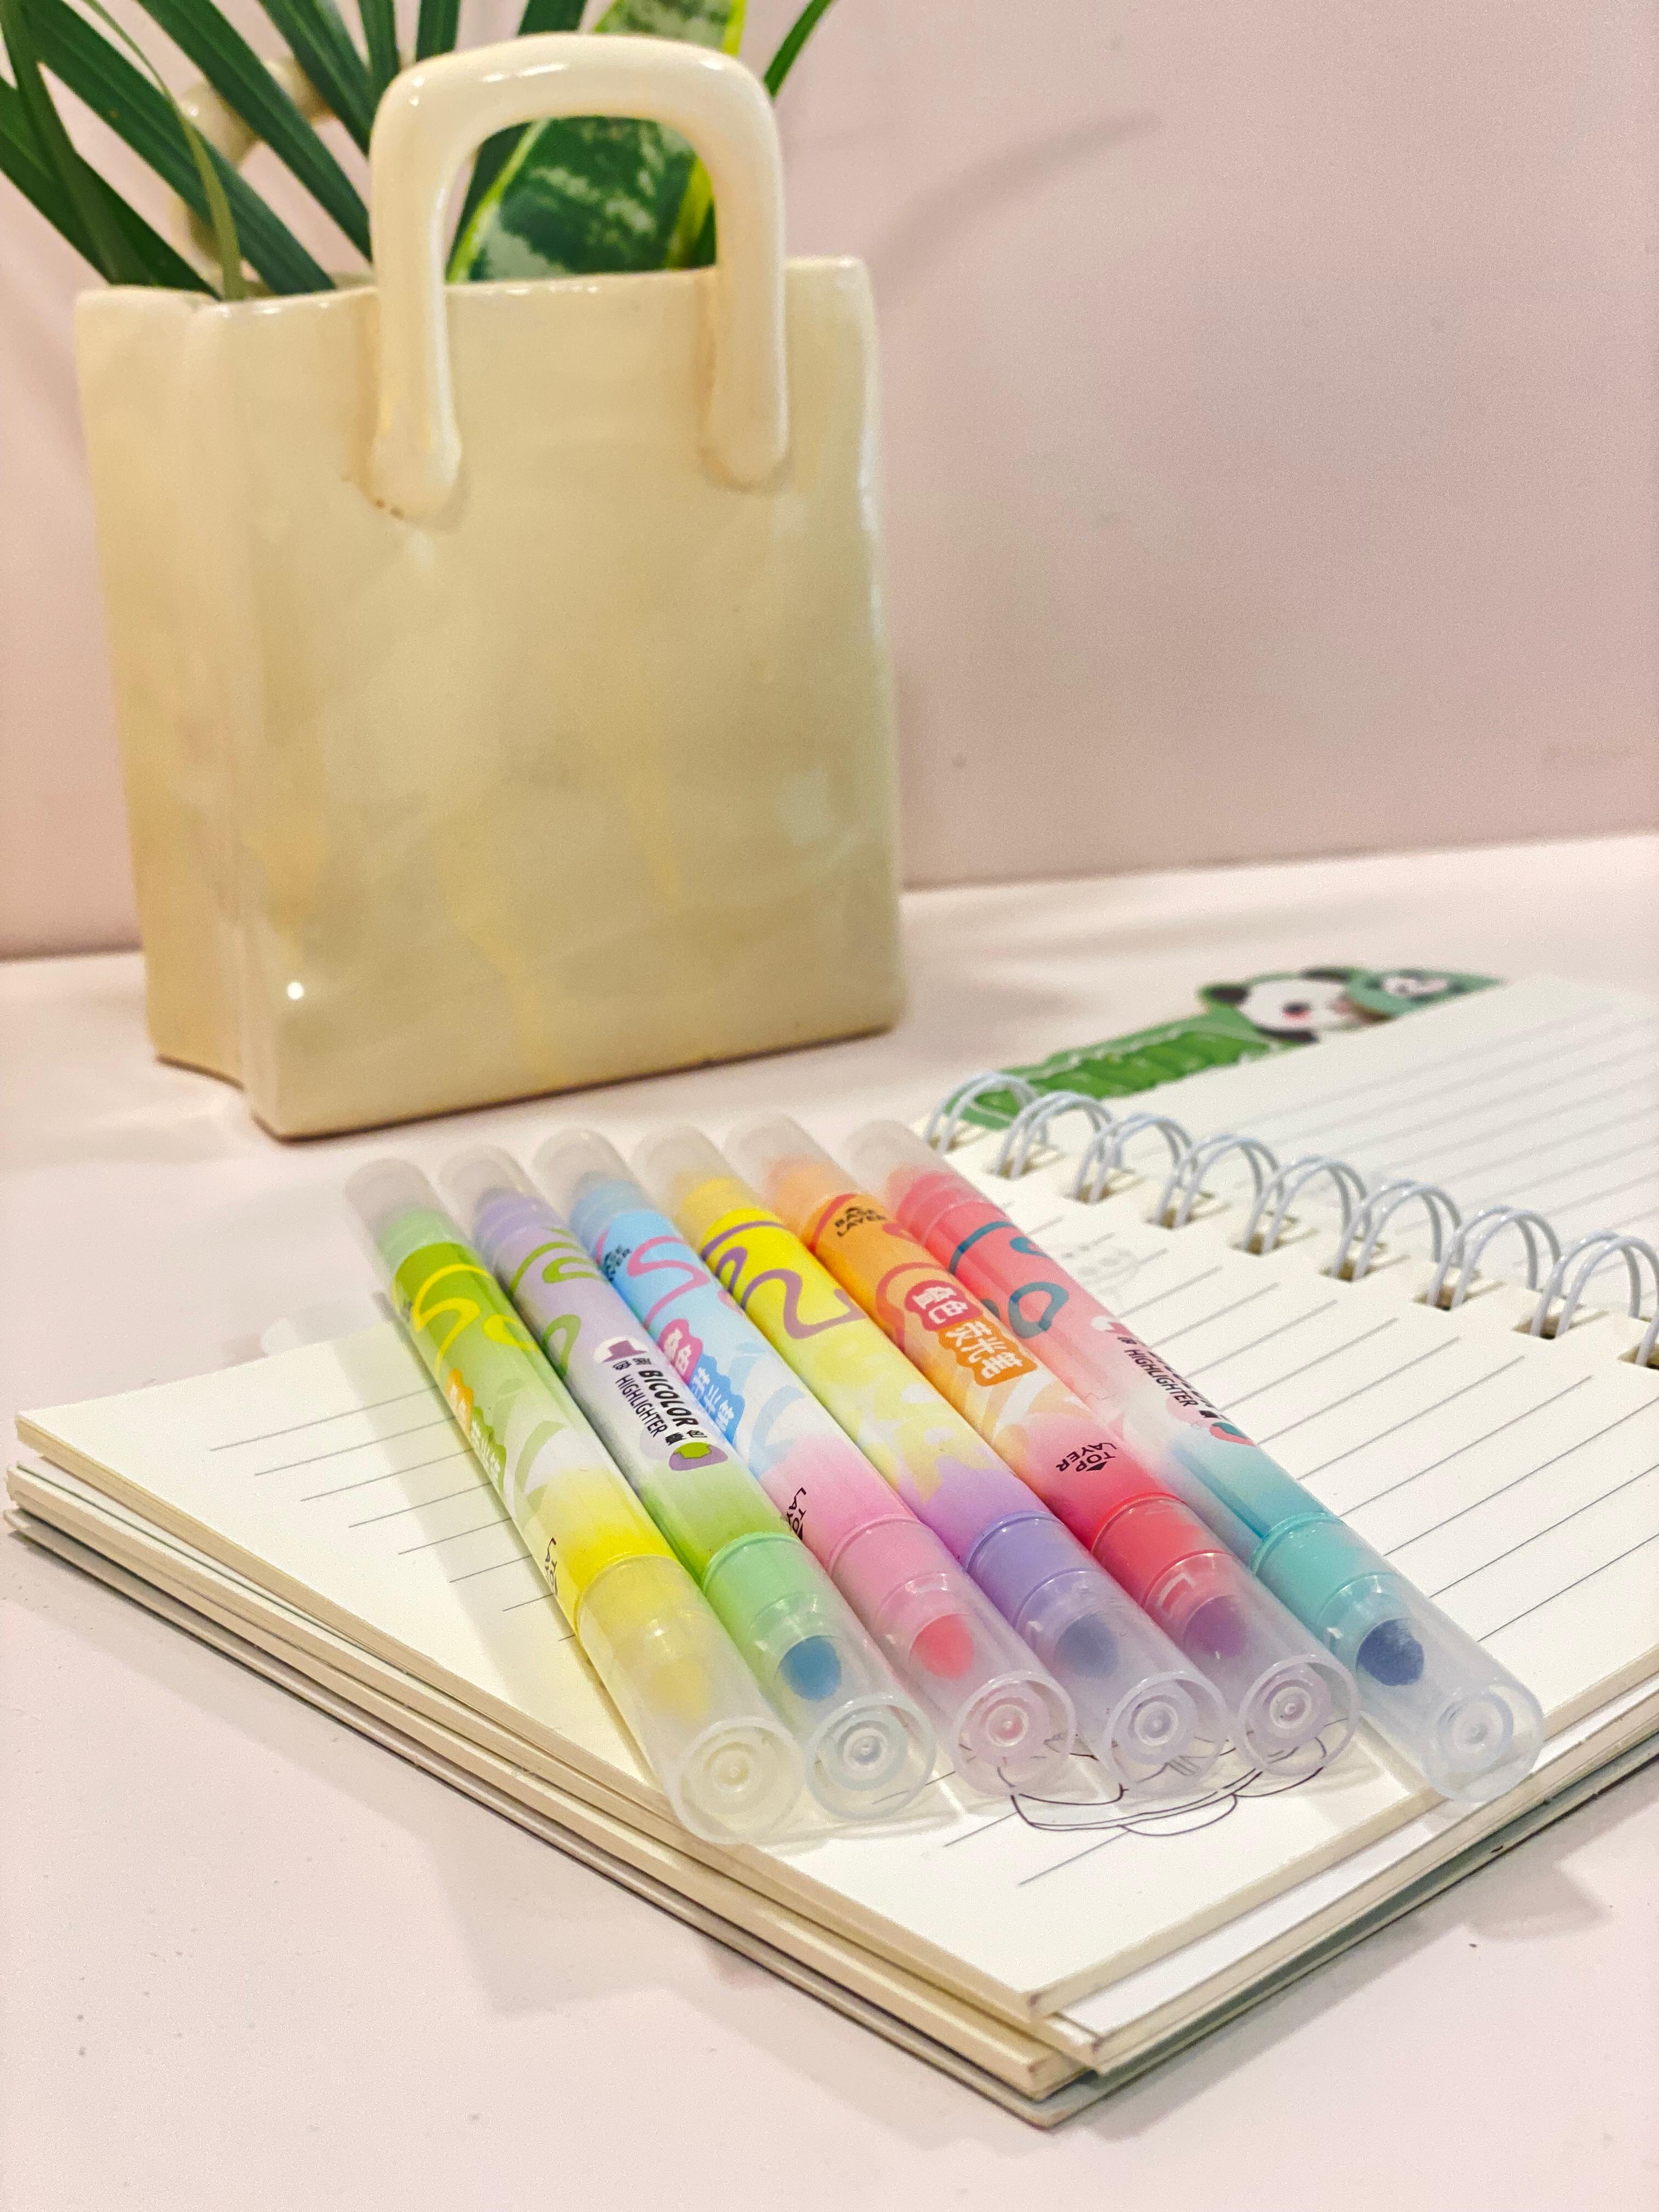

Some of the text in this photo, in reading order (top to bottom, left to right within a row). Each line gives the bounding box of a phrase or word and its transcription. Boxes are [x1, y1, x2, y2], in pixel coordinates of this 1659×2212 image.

[837, 1214, 887, 1237] LAYER
[1124, 1348, 1199, 1407] HIGHLIGHTER
[615, 1374, 669, 1438] HIGHLIGHTER
[637, 1370, 699, 1427] BICOLOR
[1055, 1442, 1118, 1472] LAYER
[1075, 1451, 1116, 1472] TOP
[786, 1487, 807, 1526] LAY
[792, 1508, 807, 1533] TO
[544, 1537, 557, 1581] LAY
[549, 1560, 558, 1587] TO
